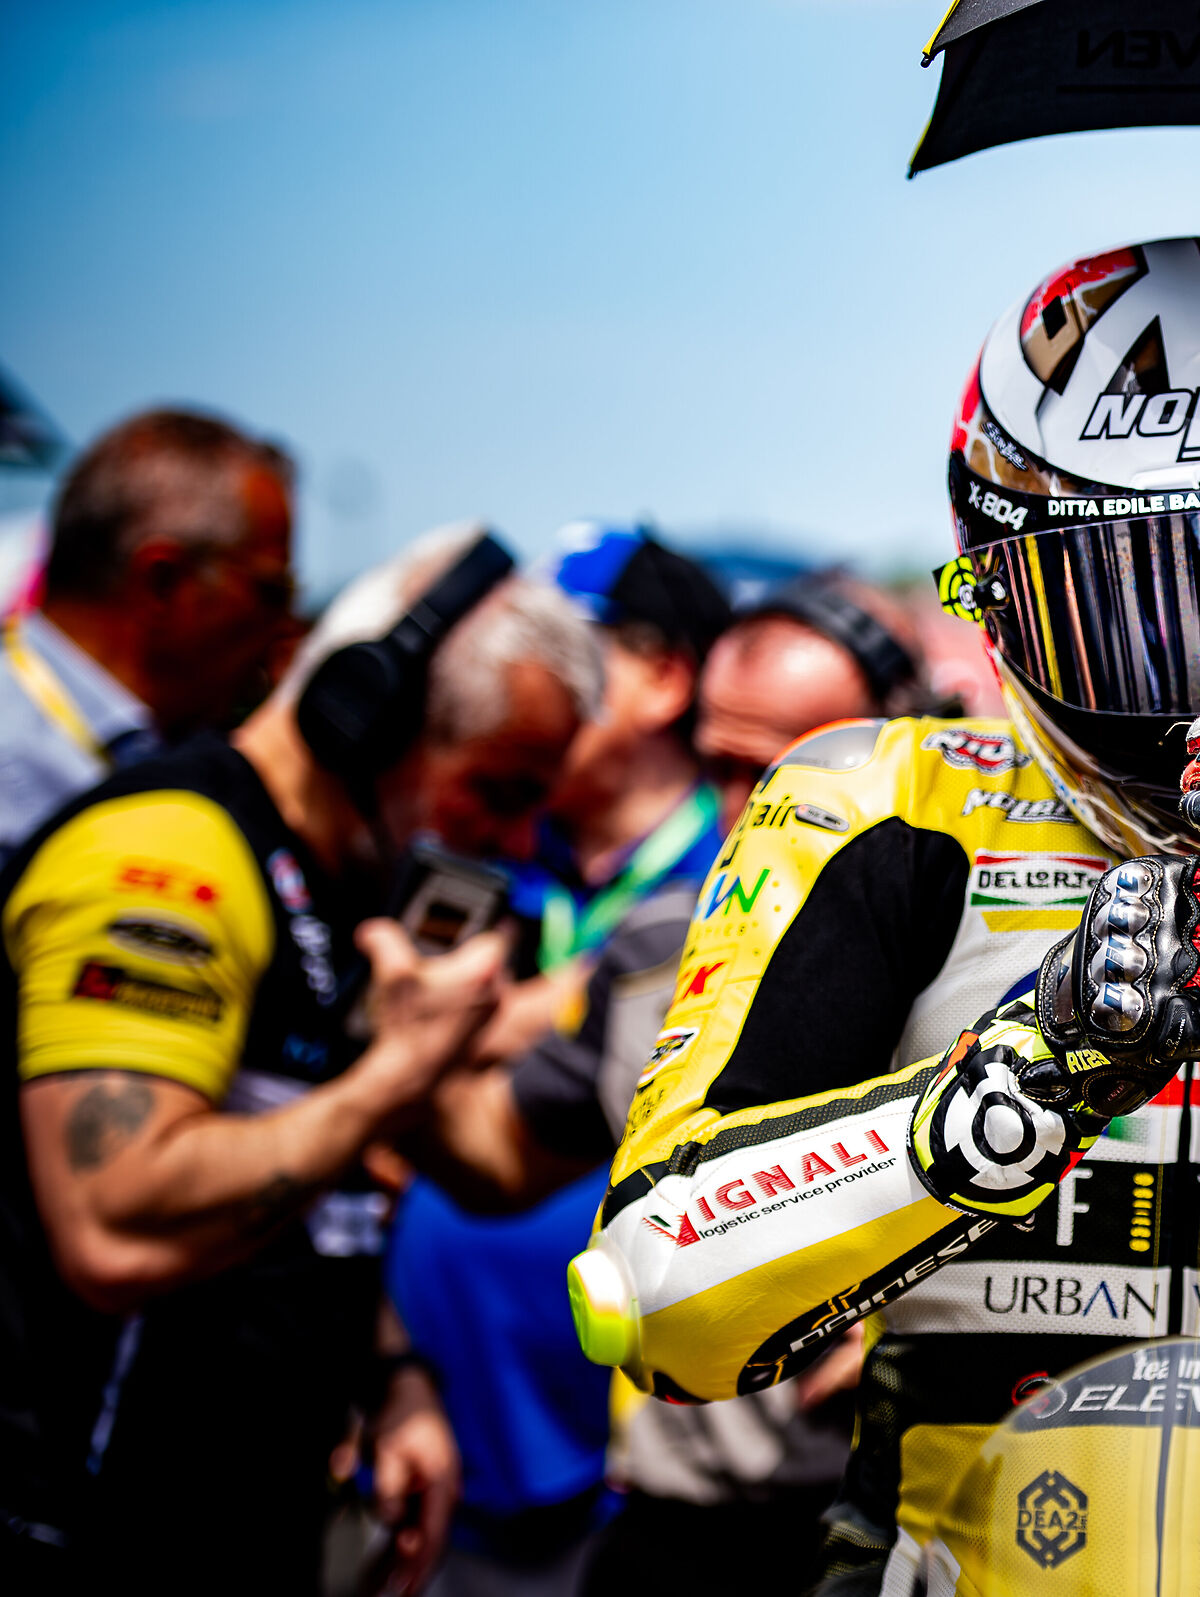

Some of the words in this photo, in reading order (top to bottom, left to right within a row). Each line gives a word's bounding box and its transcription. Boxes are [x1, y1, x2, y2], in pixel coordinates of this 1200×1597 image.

[968, 481, 1028, 531] X-804
[1048, 500, 1099, 516] DITTA
[1103, 495, 1165, 516] EDILE
[642, 1129, 890, 1248] VIGNALI
[699, 1209, 761, 1239] logistic
[761, 1185, 824, 1215] service
[826, 1157, 897, 1193] provider
[984, 1275, 1161, 1321] URBAN
